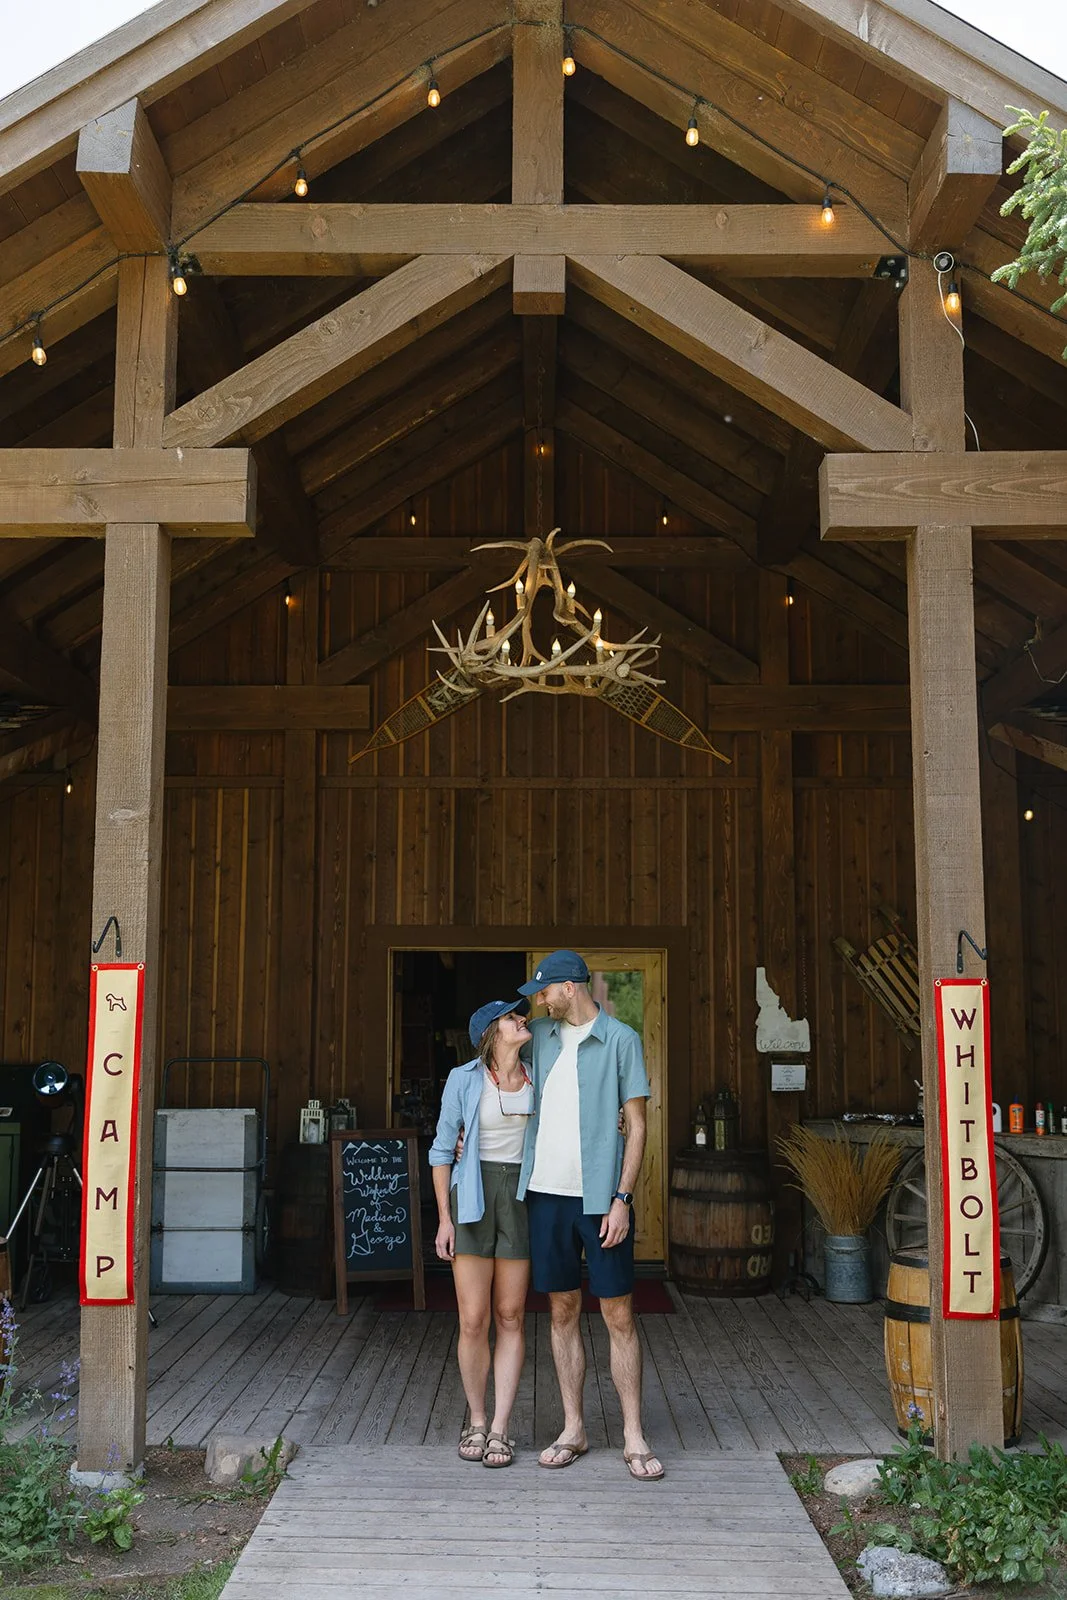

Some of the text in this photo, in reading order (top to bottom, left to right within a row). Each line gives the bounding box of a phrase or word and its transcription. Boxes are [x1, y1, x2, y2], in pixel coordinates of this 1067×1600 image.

[950, 1007, 984, 1294] WHITBOLT
[95, 1052, 123, 1279] CAMP
[343, 1166, 408, 1190] Wedding
[346, 1207, 407, 1234] Madison
[373, 1223, 385, 1233] &
[347, 1229, 407, 1259] George
